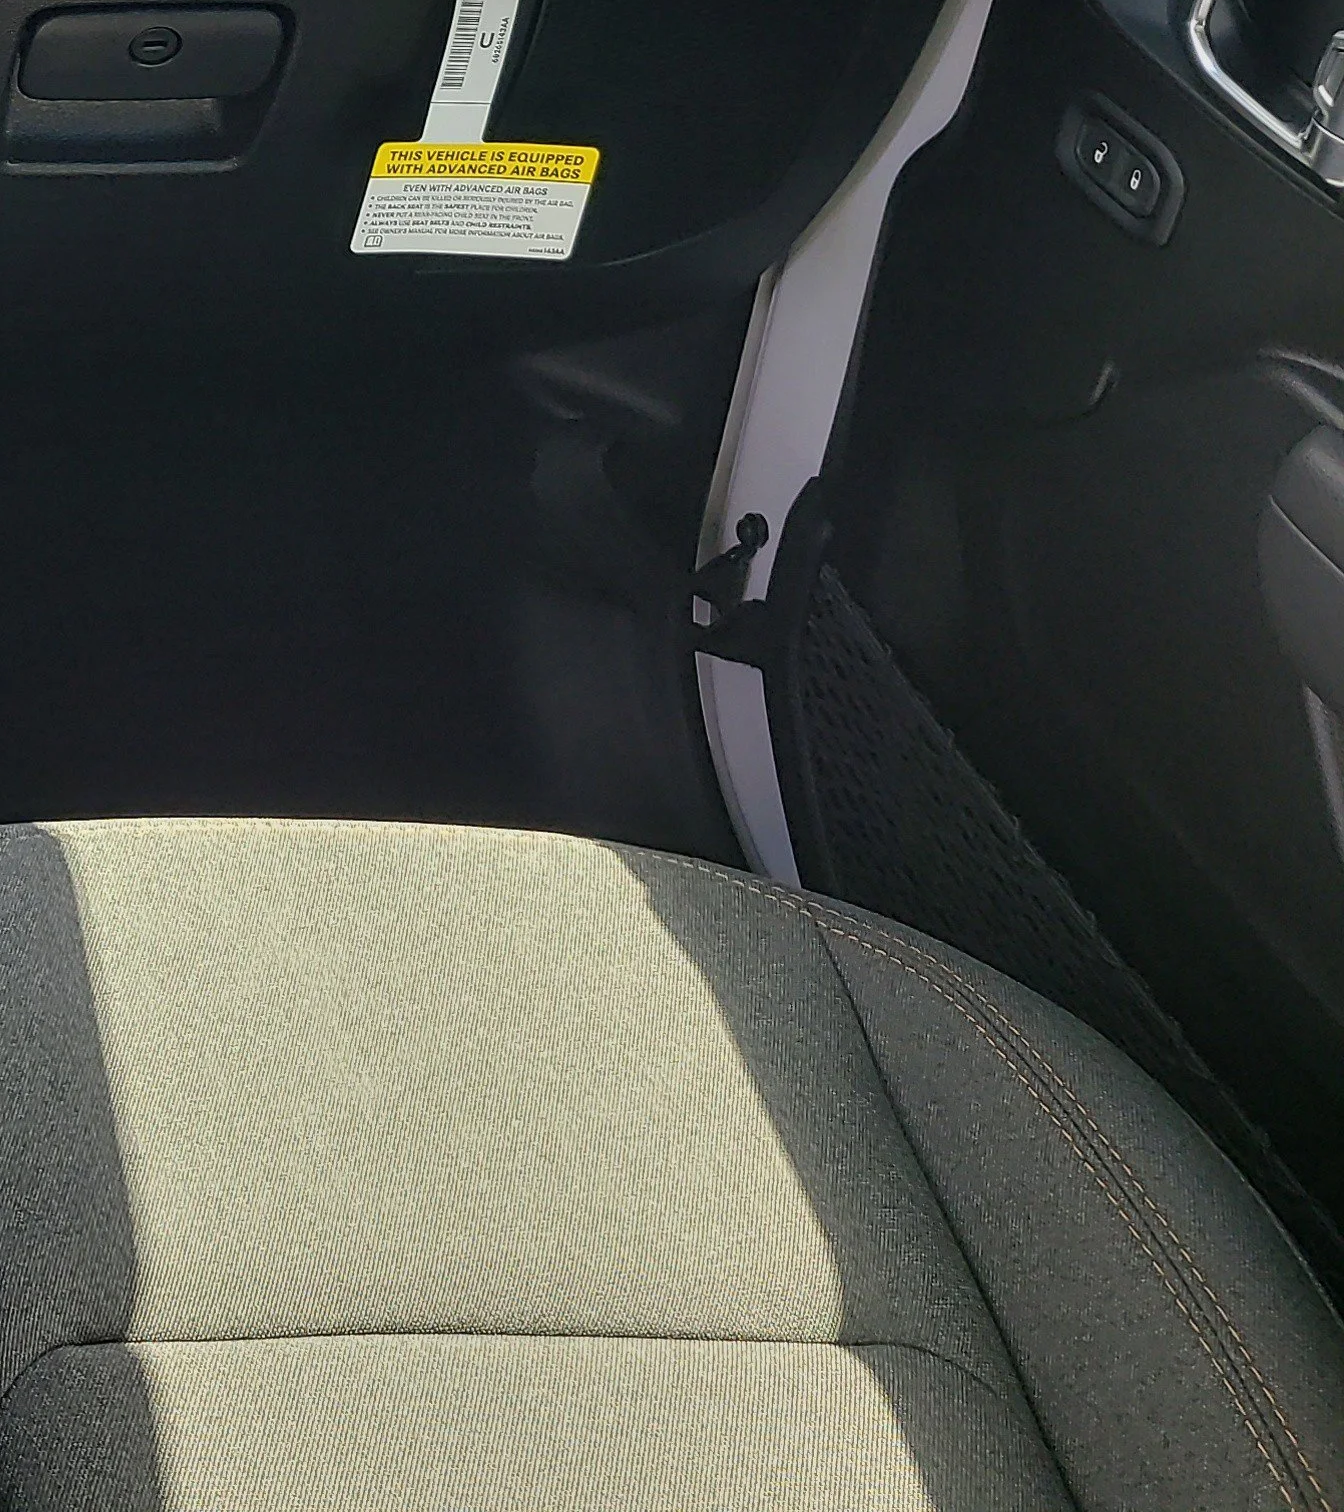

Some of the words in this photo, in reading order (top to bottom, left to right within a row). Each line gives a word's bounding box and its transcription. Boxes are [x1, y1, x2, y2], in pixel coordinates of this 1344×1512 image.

[480, 32, 495, 49] U
[389, 150, 423, 161] THIS
[426, 150, 488, 162] VEHICLE
[490, 152, 505, 162] IS
[507, 152, 585, 166] EQUIPPED
[386, 163, 424, 175] WITH
[426, 164, 508, 175] ADVANCED
[511, 166, 537, 177] AIR
[539, 167, 582, 179] BAGS
[402, 184, 428, 192] EVEN
[428, 184, 452, 192] WITH
[453, 185, 504, 194] ADVANCED
[504, 186, 522, 194] AIR
[522, 187, 549, 196] BAGS
